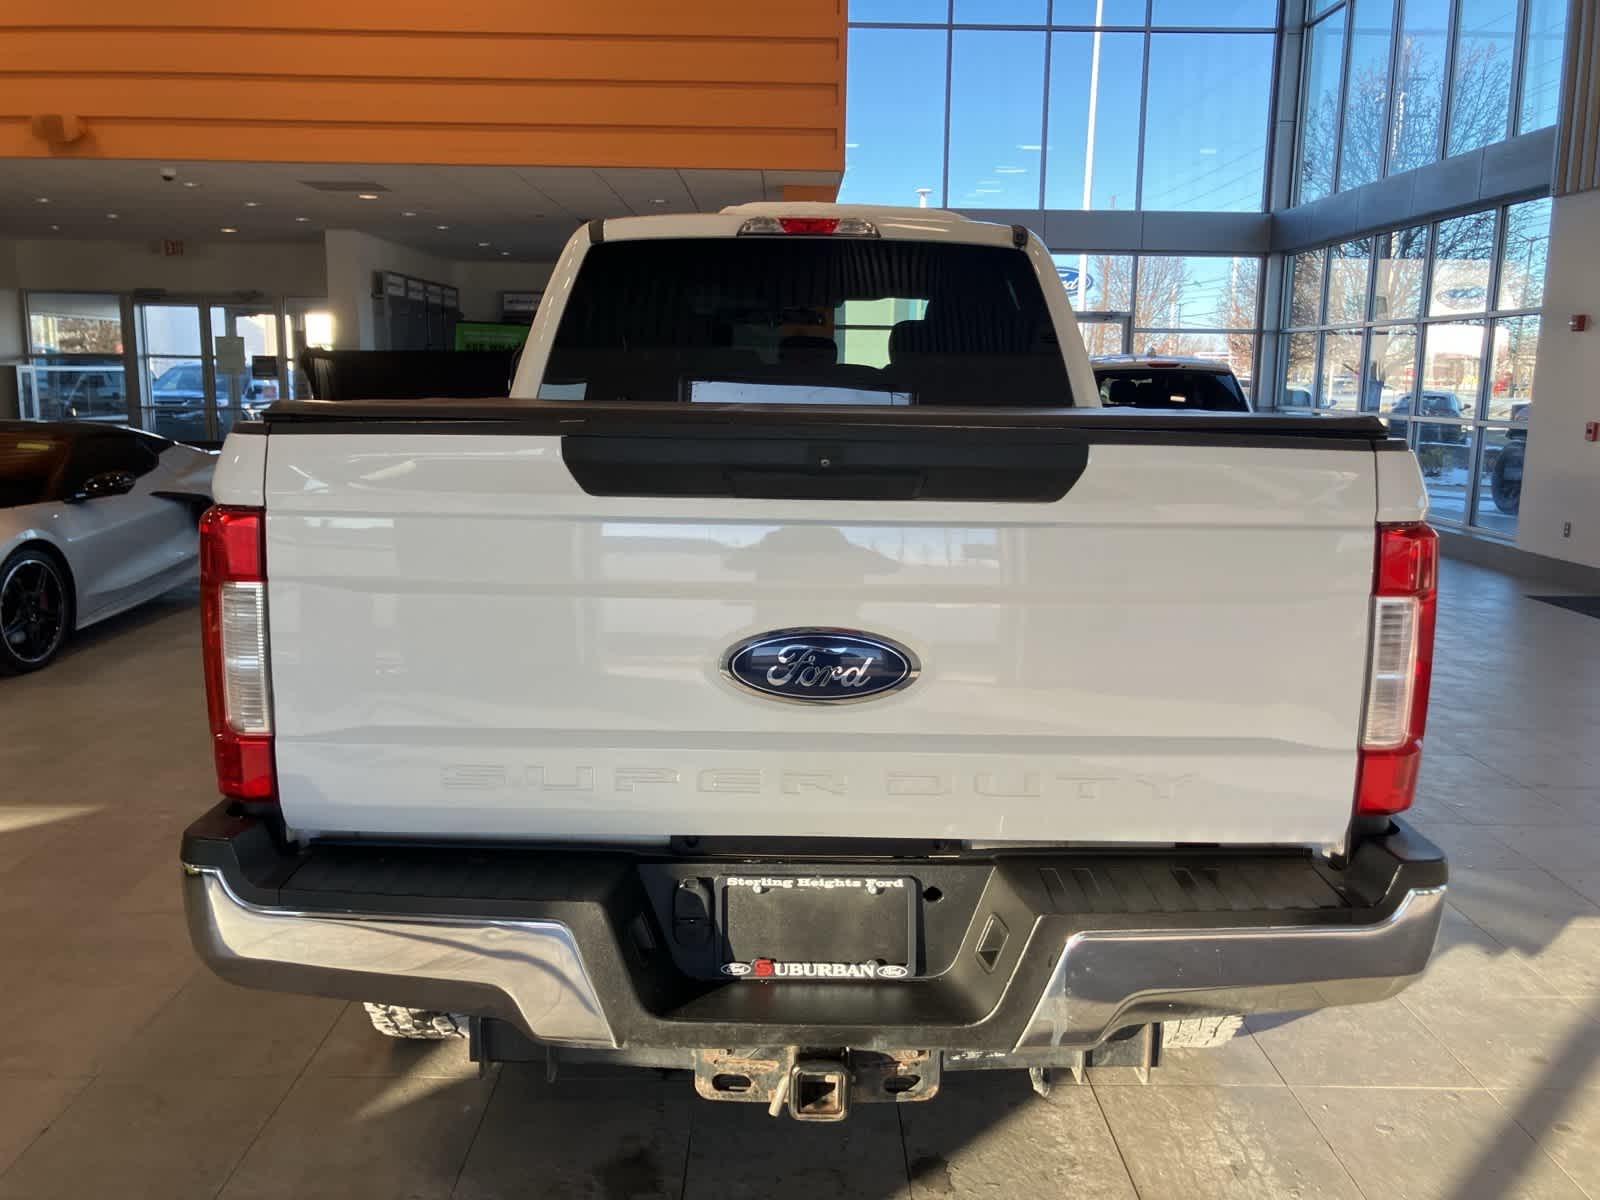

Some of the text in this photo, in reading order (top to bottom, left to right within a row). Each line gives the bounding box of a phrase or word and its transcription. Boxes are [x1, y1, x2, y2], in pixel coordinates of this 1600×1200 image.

[767, 643, 874, 688] Ford
[440, 763, 1194, 801] SUPER DUTY
[726, 876, 905, 889] Sterling Heights Ford
[754, 959, 875, 977] SUBURBAN
